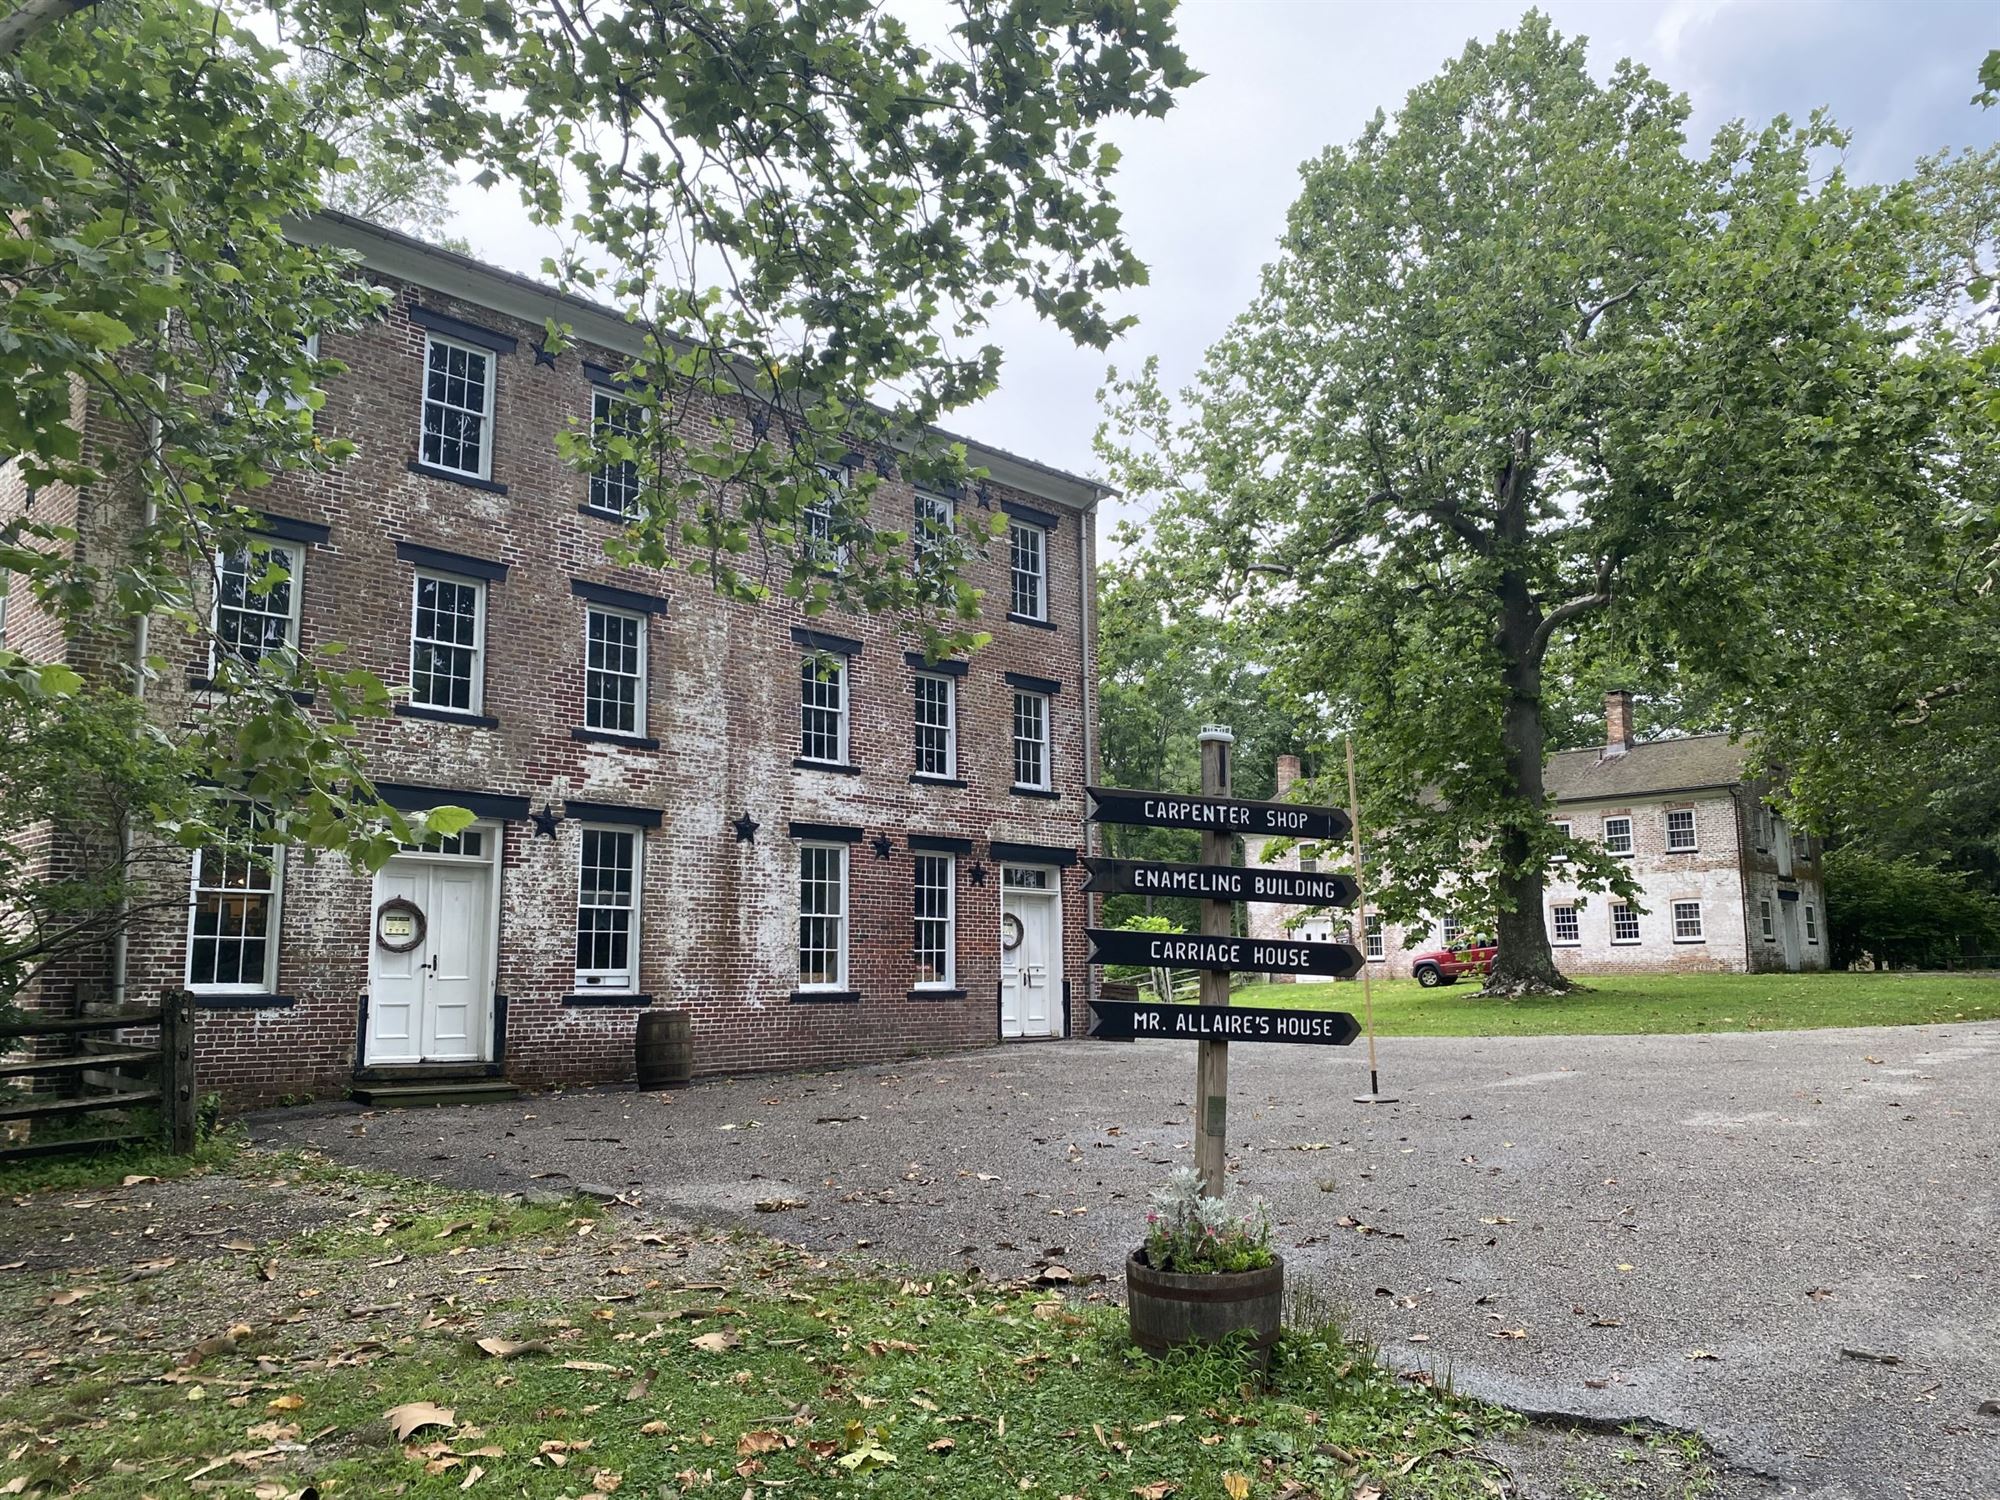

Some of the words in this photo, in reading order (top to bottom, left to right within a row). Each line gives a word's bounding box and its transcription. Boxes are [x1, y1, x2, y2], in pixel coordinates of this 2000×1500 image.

[1144, 800, 1251, 825] CARPENTER
[1266, 810, 1308, 829] SHOP
[1134, 869, 1242, 893] ENAMELING
[1254, 876, 1335, 899] BUILDING
[1150, 940, 1240, 963] CARRIAGE
[1253, 947, 1310, 967] HOUSE
[1133, 1012, 1166, 1031] MR.
[1175, 1012, 1270, 1035] ALLAIRE'S
[1277, 1018, 1333, 1036] HOUSE
